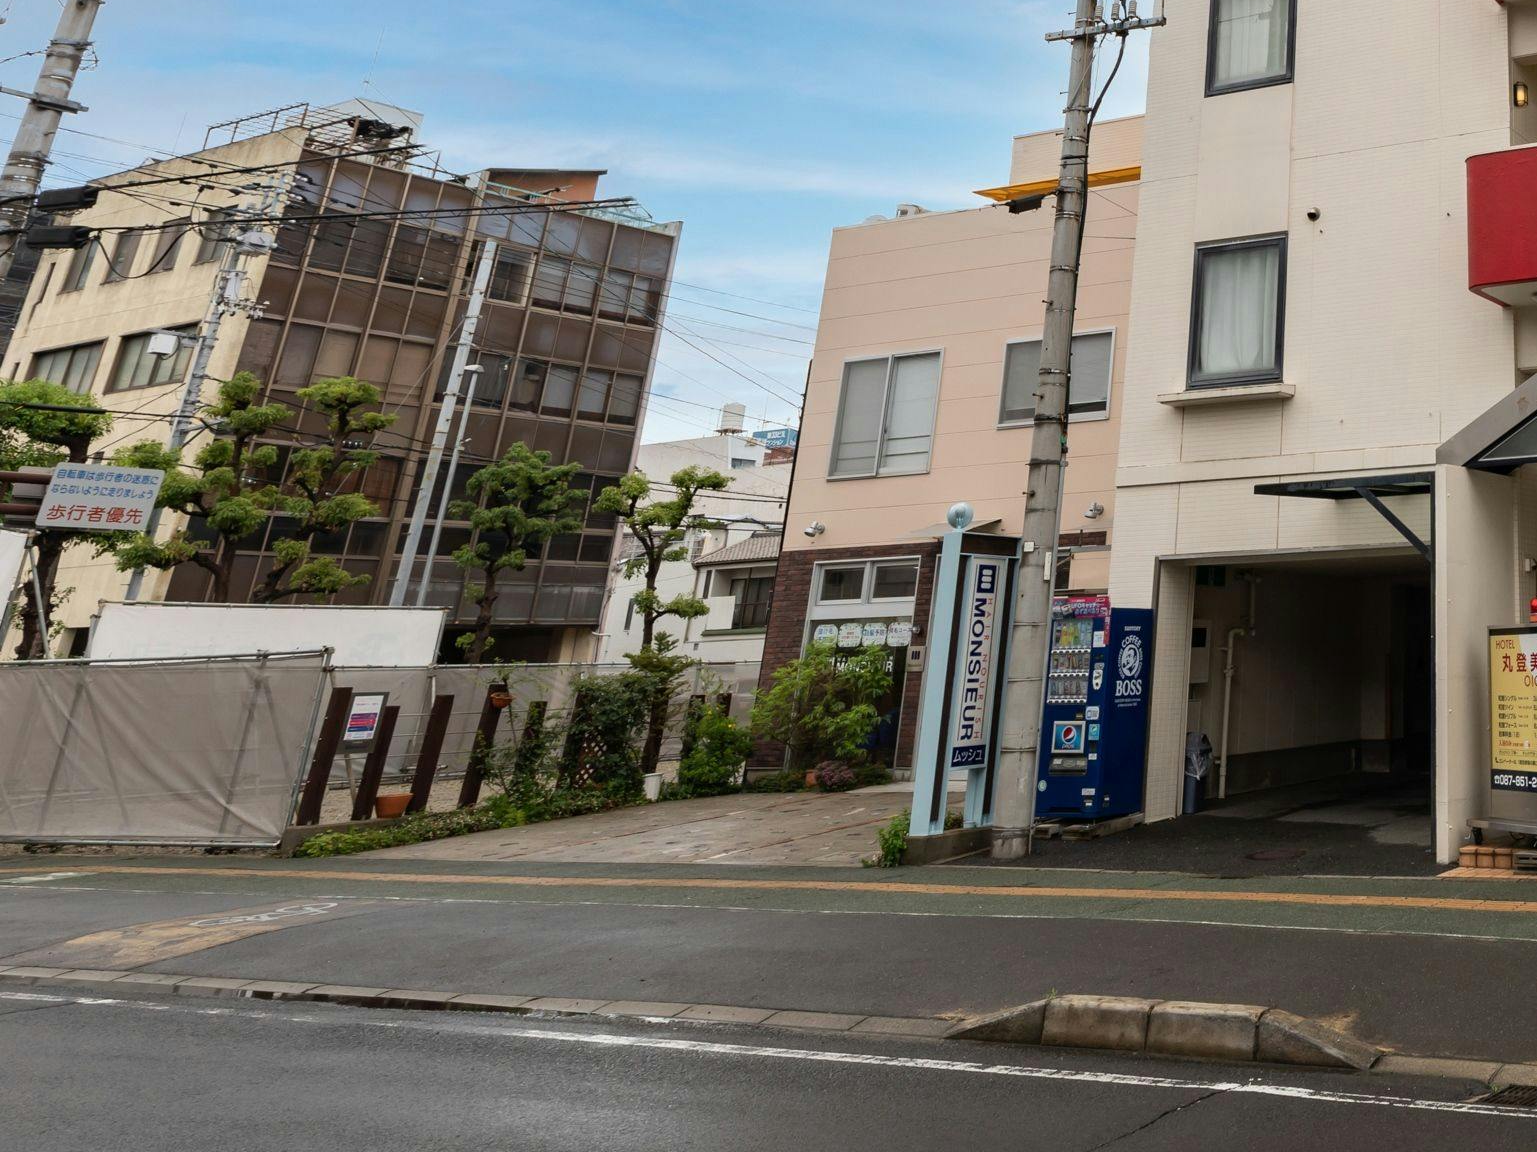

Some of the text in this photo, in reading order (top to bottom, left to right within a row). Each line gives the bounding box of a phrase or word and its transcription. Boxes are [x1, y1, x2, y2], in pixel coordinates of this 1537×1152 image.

[56, 469, 159, 485] 自転車は歩行者の迷惑に
[51, 484, 154, 499] ならないように走りましょう
[46, 505, 143, 524] 歩行者優先
[1121, 635, 1142, 648] COFFEE
[1495, 640, 1515, 649] HOTEL
[960, 598, 987, 741] MONSIEUR
[973, 598, 993, 739] HAIR NOURISH
[1115, 680, 1142, 696] BOSS
[953, 748, 983, 762] ムッシュ
